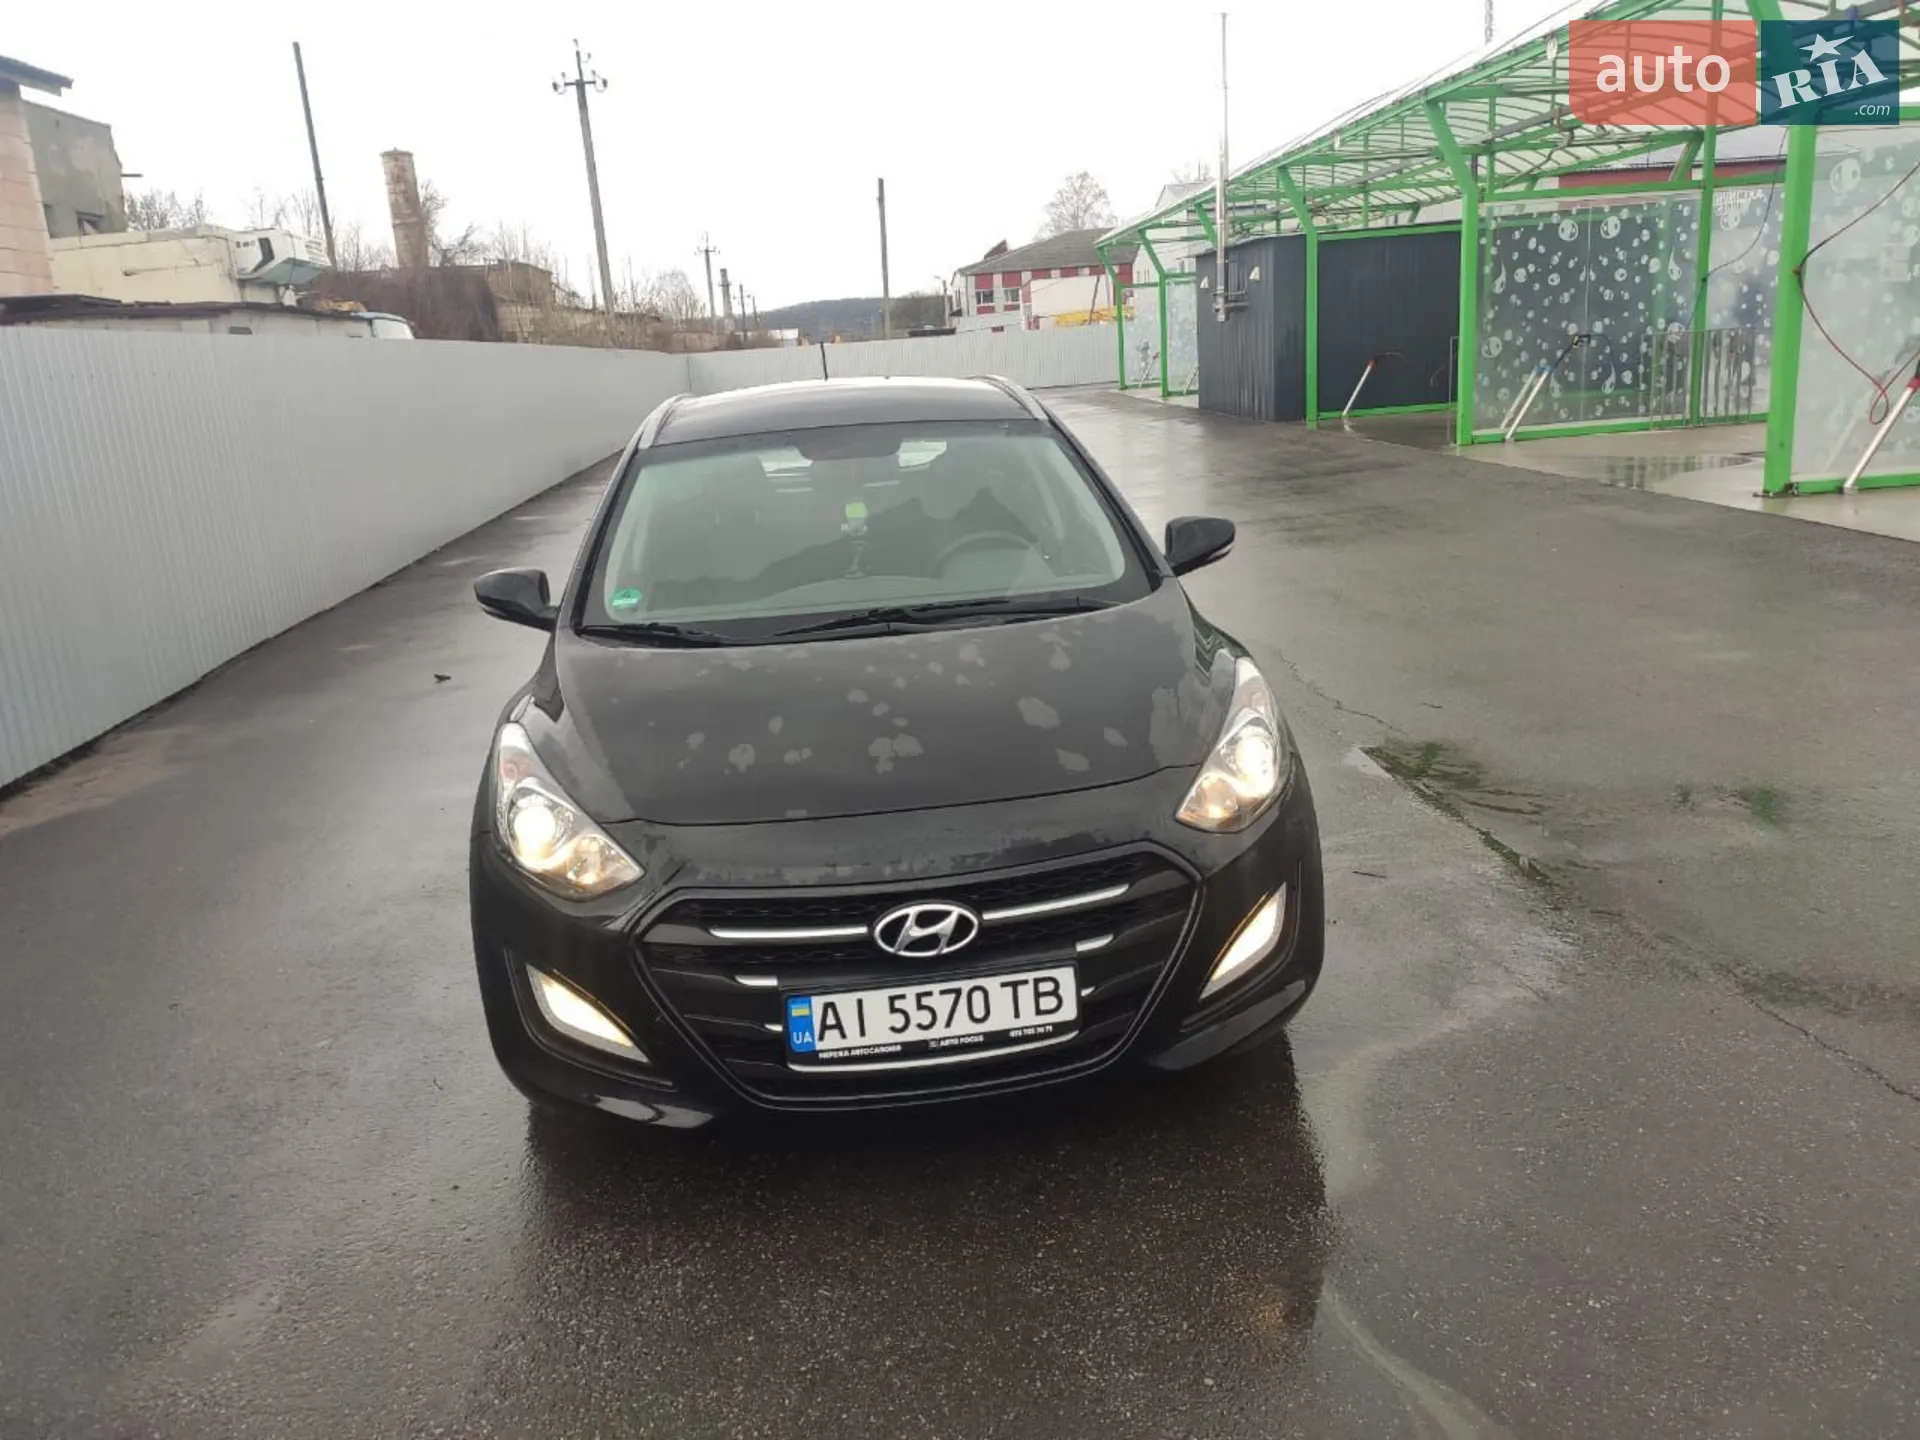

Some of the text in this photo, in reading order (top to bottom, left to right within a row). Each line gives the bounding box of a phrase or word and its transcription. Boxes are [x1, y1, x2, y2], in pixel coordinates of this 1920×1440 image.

[817, 976, 1064, 1042] AI 5570 TB
[792, 1032, 813, 1044] UA
